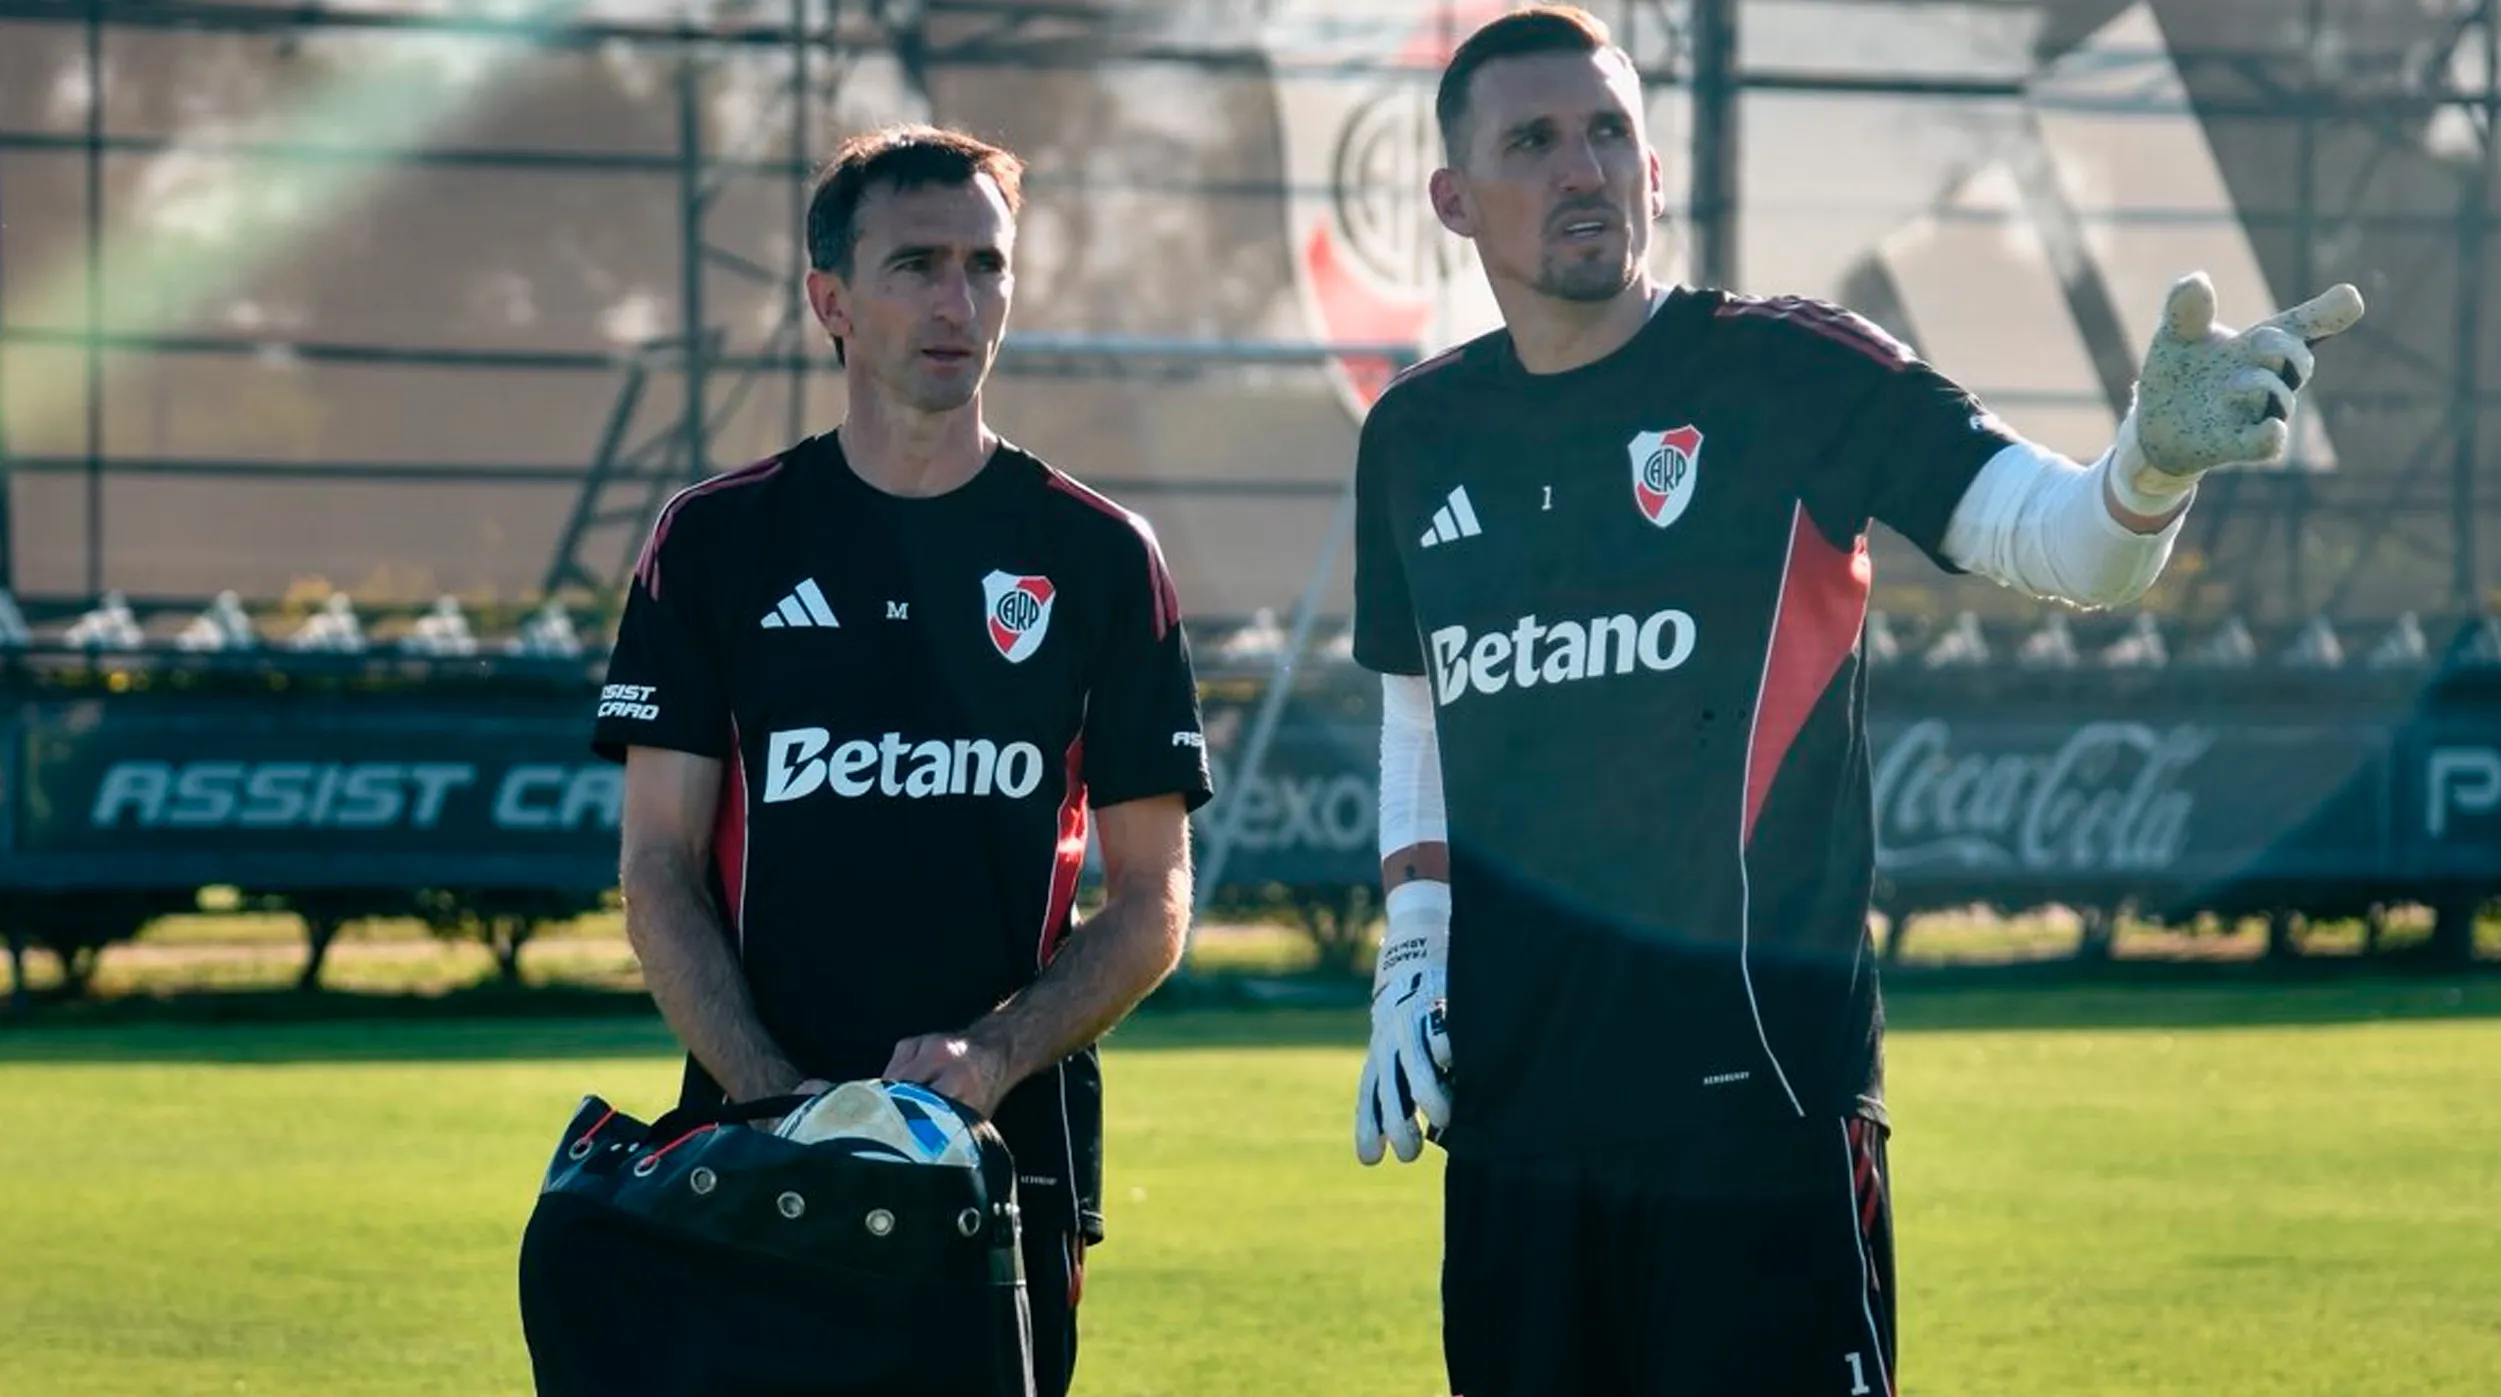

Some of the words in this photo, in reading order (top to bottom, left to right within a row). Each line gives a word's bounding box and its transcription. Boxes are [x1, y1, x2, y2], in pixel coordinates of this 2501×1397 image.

[1643, 448, 1687, 493] CARP
[1541, 485, 1553, 511] 1
[886, 600, 909, 620] M
[996, 590, 1040, 631] CARP
[1430, 608, 1697, 707] Betano
[597, 701, 660, 720] CARD
[763, 727, 1043, 803] Betano
[92, 759, 476, 828] ASSIST
[491, 760, 625, 828] CA
[1845, 1352, 1870, 1396] 1
